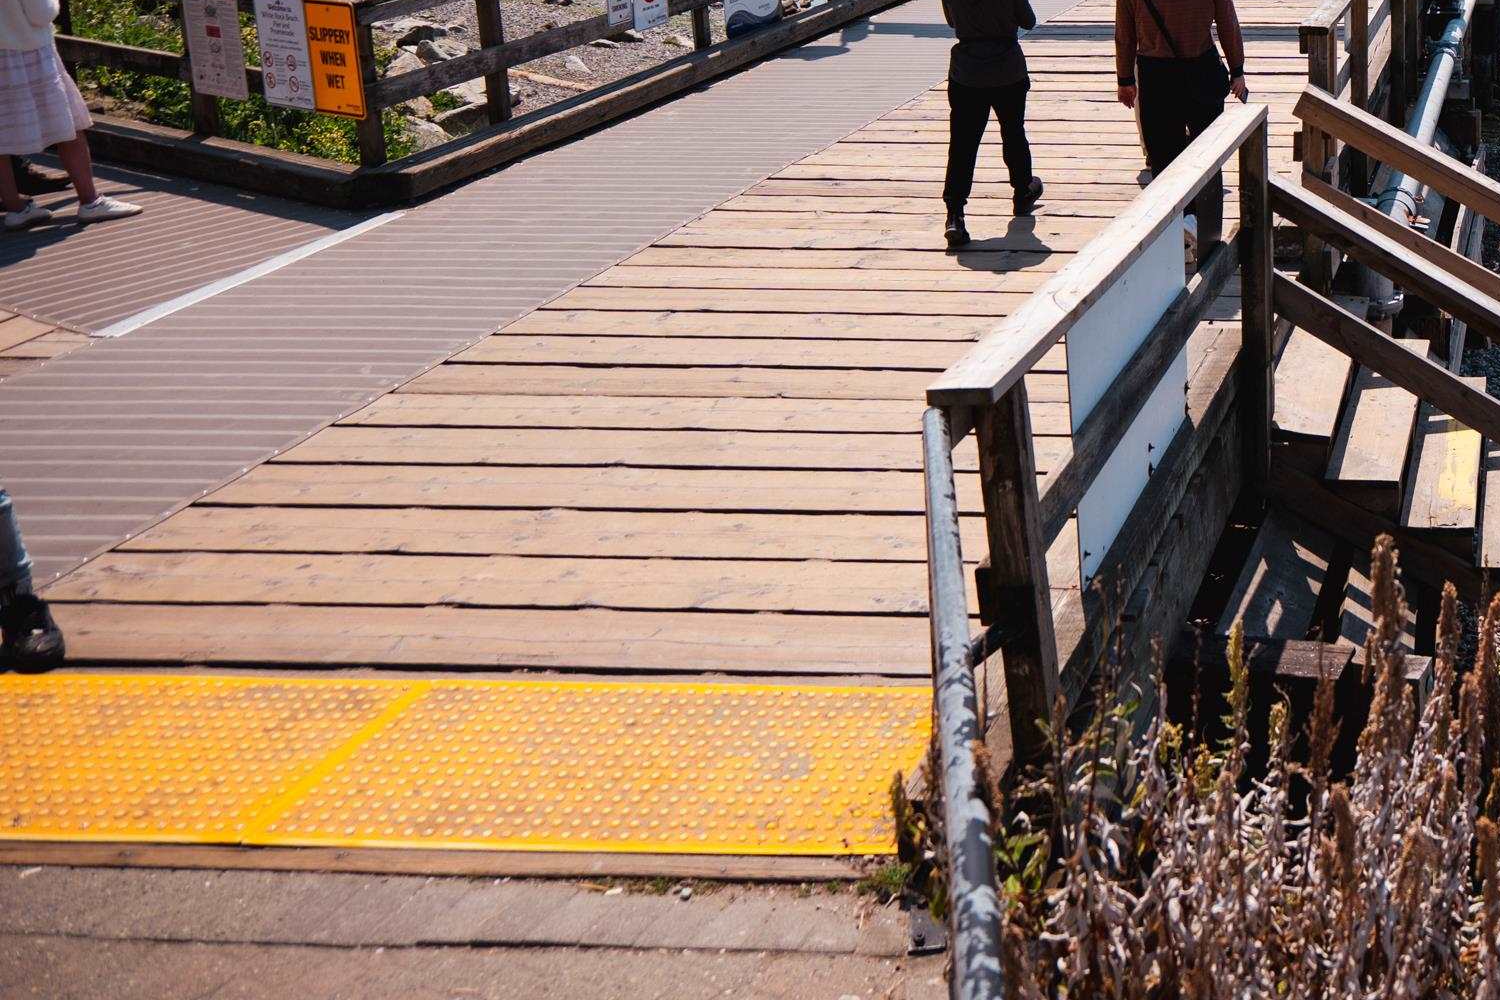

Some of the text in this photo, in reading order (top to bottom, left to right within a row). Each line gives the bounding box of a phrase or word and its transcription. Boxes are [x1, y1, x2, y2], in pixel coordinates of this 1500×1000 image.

[308, 26, 350, 45] SLIPPERY
[320, 50, 346, 67] WHEN
[326, 73, 345, 89] WET
